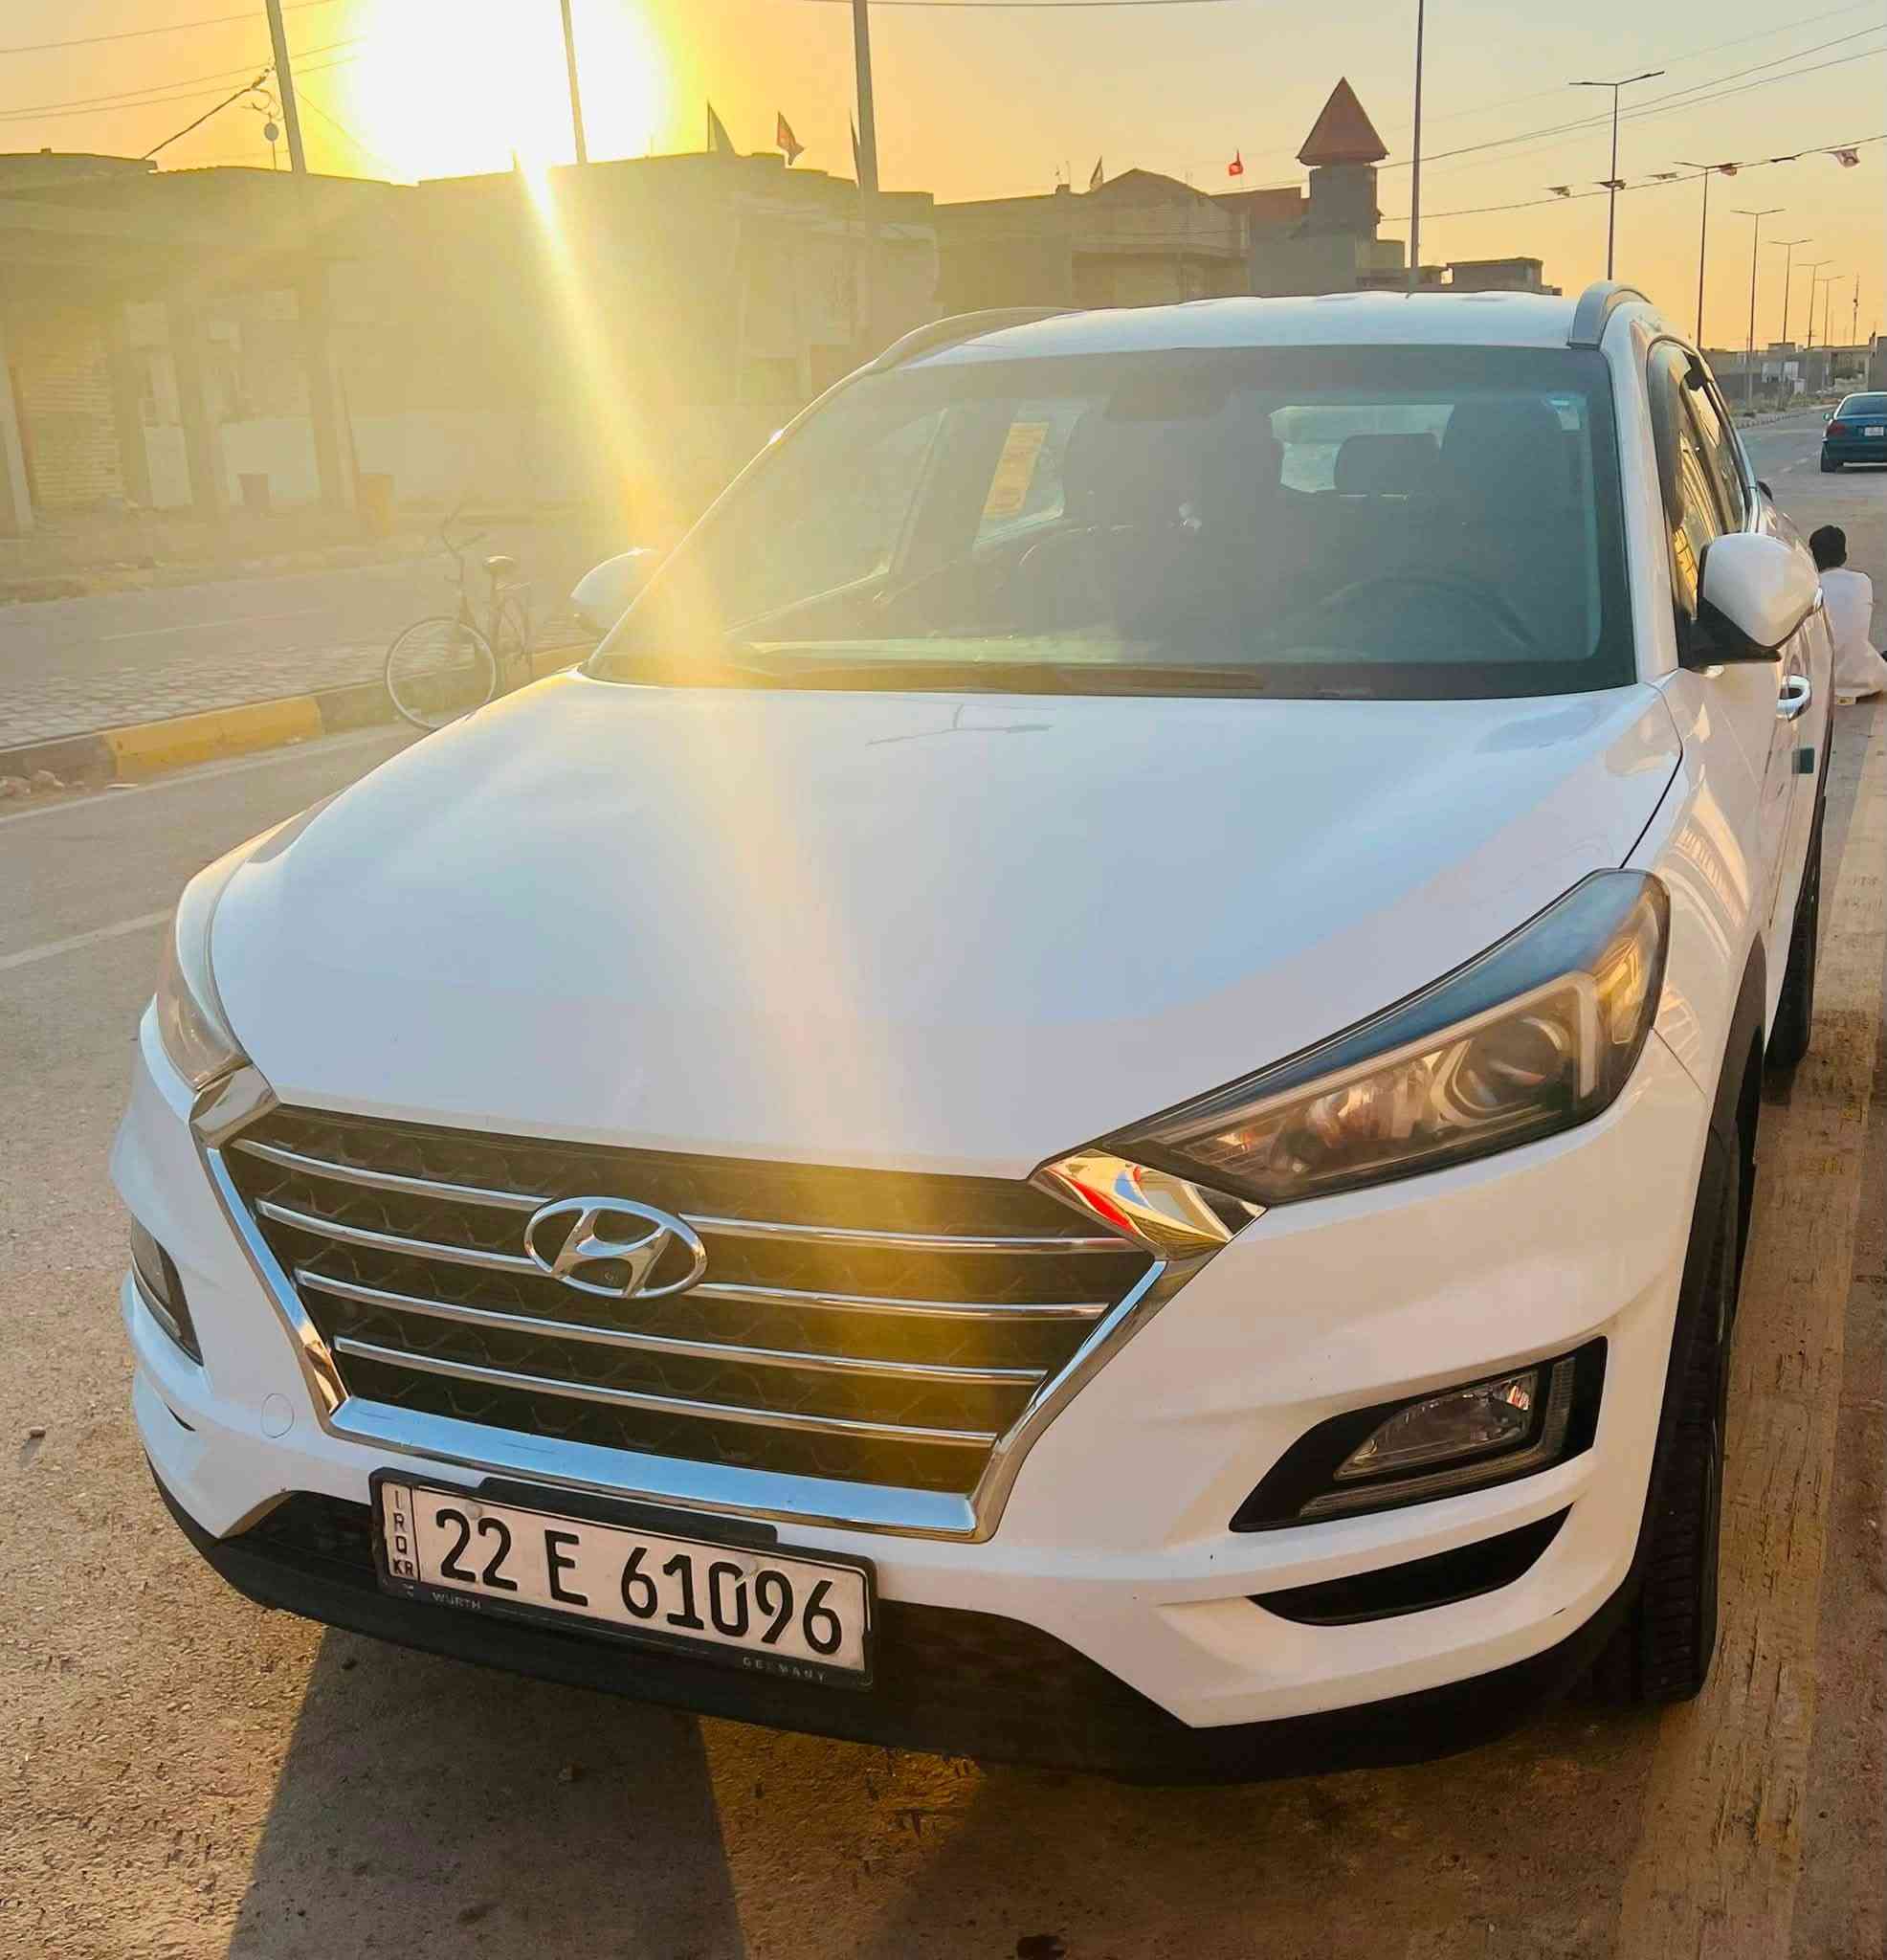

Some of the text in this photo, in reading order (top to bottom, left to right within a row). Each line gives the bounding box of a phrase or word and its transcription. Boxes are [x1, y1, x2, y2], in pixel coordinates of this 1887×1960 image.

[393, 1490, 407, 1555] IRQ
[392, 1557, 414, 1577] KR
[435, 1508, 842, 1655] 22 E 61096
